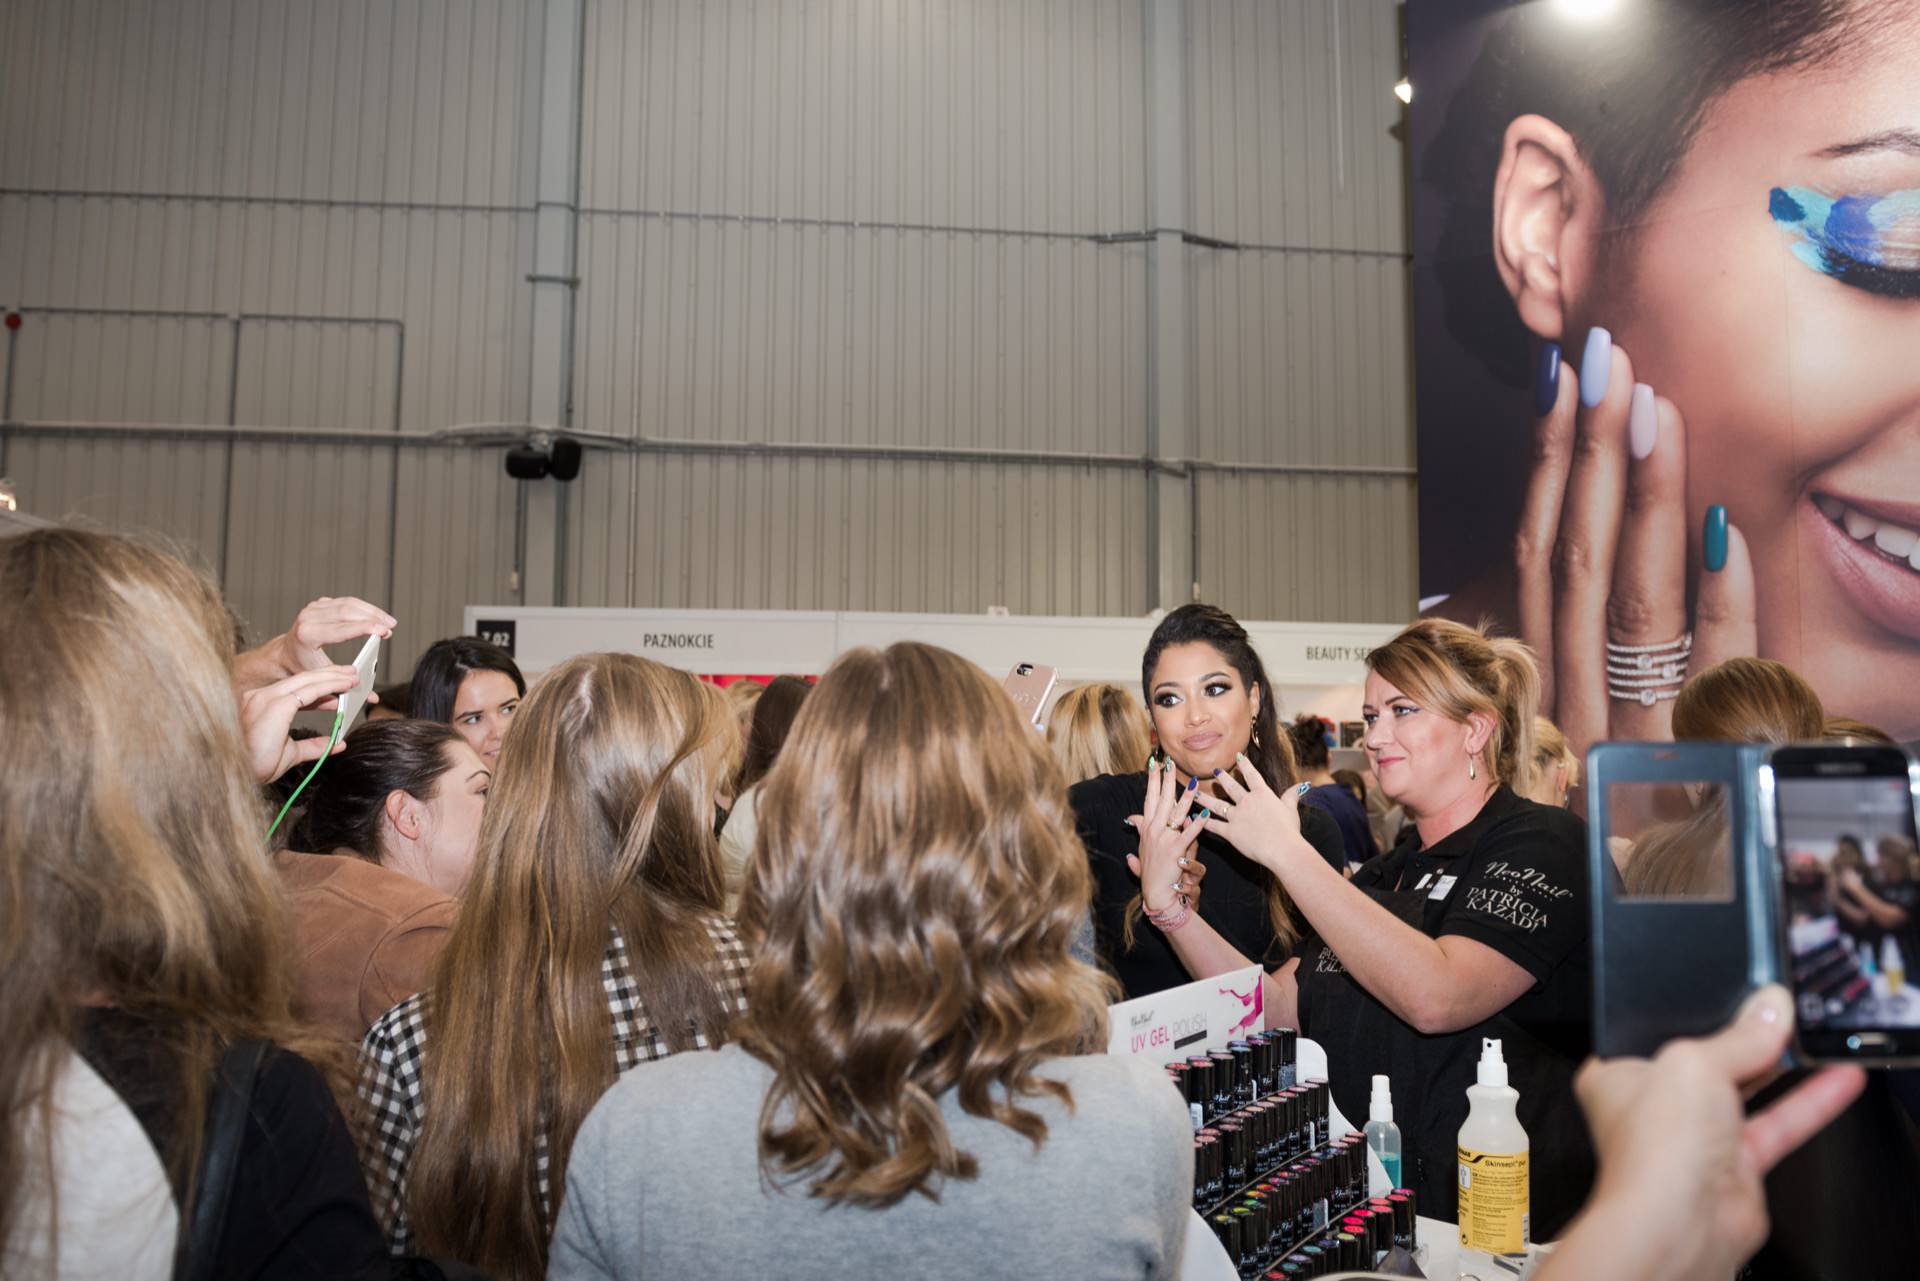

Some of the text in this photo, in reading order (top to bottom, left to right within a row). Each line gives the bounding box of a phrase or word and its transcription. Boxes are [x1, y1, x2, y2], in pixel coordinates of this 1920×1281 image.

[643, 633, 714, 648] PAZNOKCIE
[1306, 646, 1351, 661] BEAUTY
[1509, 884, 1523, 898] by
[1466, 886, 1548, 928] PATRICIA
[1466, 897, 1538, 933] KAZADI
[1131, 1011, 1208, 1053] UV GEL POLISH
